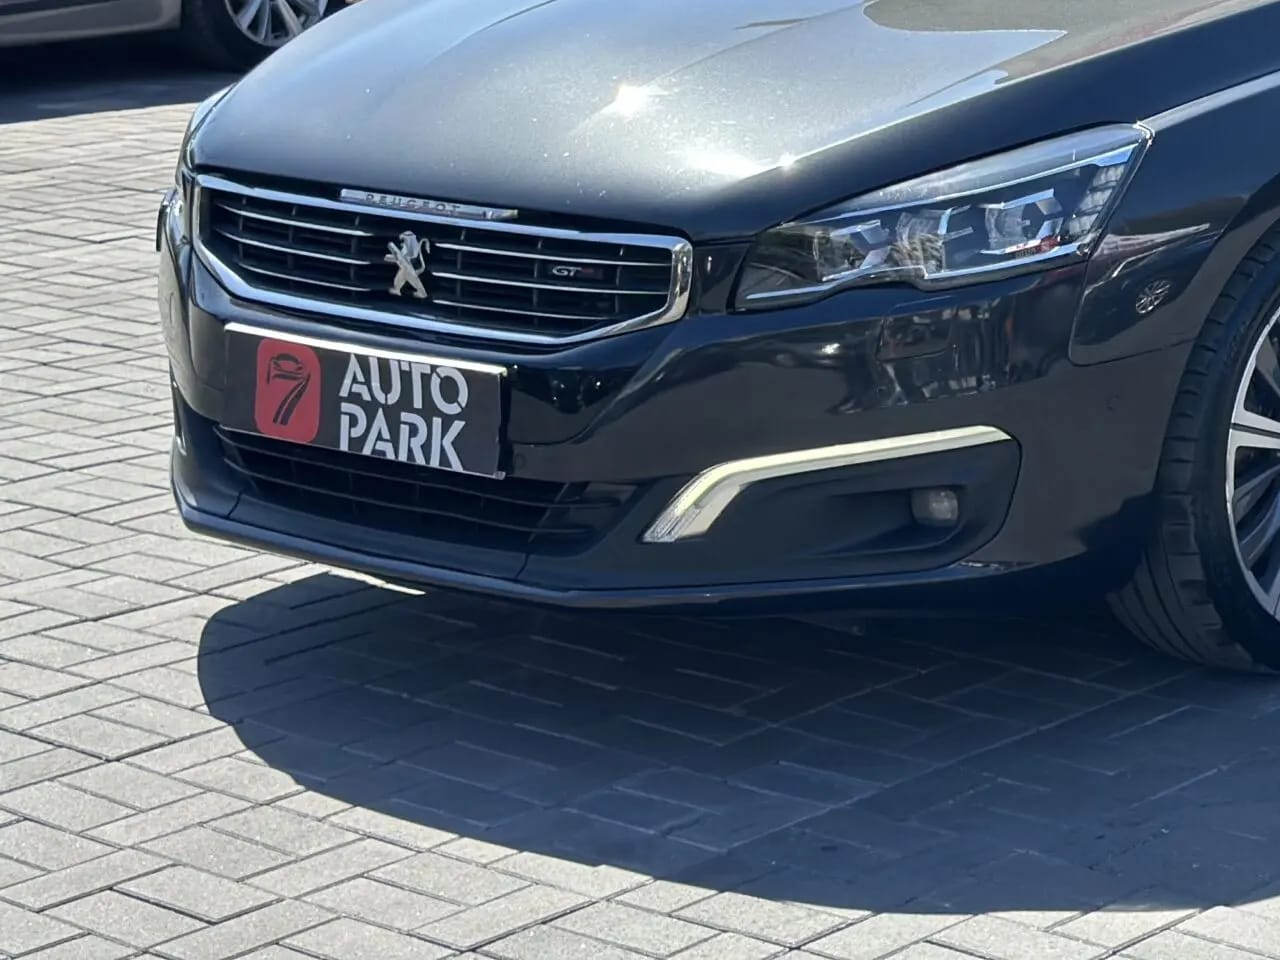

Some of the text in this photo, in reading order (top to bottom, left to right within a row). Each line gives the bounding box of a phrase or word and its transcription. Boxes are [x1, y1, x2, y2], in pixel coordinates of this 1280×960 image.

[365, 192, 461, 213] PEUGEOT
[552, 265, 583, 277] GT
[339, 353, 469, 415] AUTO
[340, 402, 466, 473] PARK
